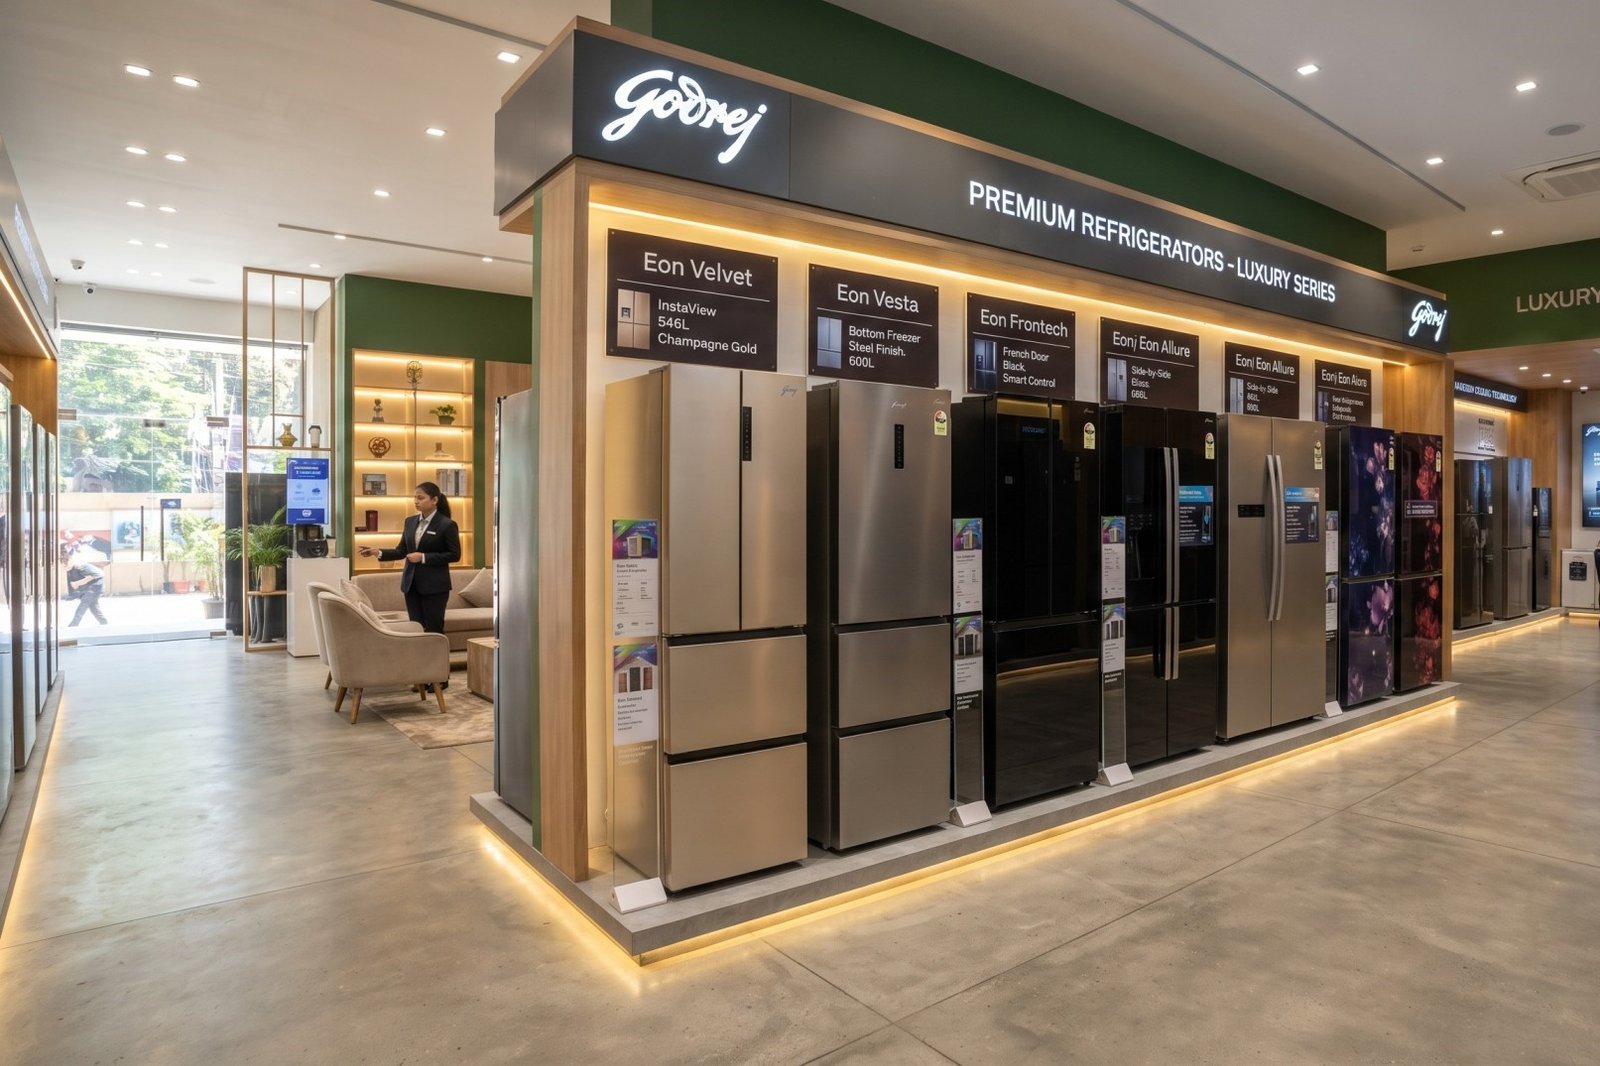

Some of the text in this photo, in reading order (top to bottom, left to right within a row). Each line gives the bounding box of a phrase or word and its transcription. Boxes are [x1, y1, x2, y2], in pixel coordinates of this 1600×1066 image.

[602, 69, 767, 164] Godrej
[969, 180, 1075, 232] PREMIUM
[1081, 211, 1224, 272] REFRIGERATORS
[1237, 257, 1291, 290] LUXURY
[1293, 274, 1336, 302] SERIES
[644, 251, 753, 287] Eon Velvet
[658, 298, 717, 317] InstaView
[837, 283, 919, 313] Eon Vesta
[1516, 286, 1600, 313] LUXURY
[658, 316, 690, 330] 546L
[981, 308, 1068, 338] Eon Frontech
[657, 332, 757, 355] Champagne Gold
[849, 325, 921, 344] Bottom Freezer
[848, 340, 906, 357] Steel Finish.
[1003, 346, 1050, 362] French Door
[1139, 335, 1160, 352] Eon
[1161, 339, 1191, 358] Allure
[849, 355, 875, 368] 600L
[1256, 357, 1272, 371] Eon
[1003, 372, 1056, 388] Smart Control
